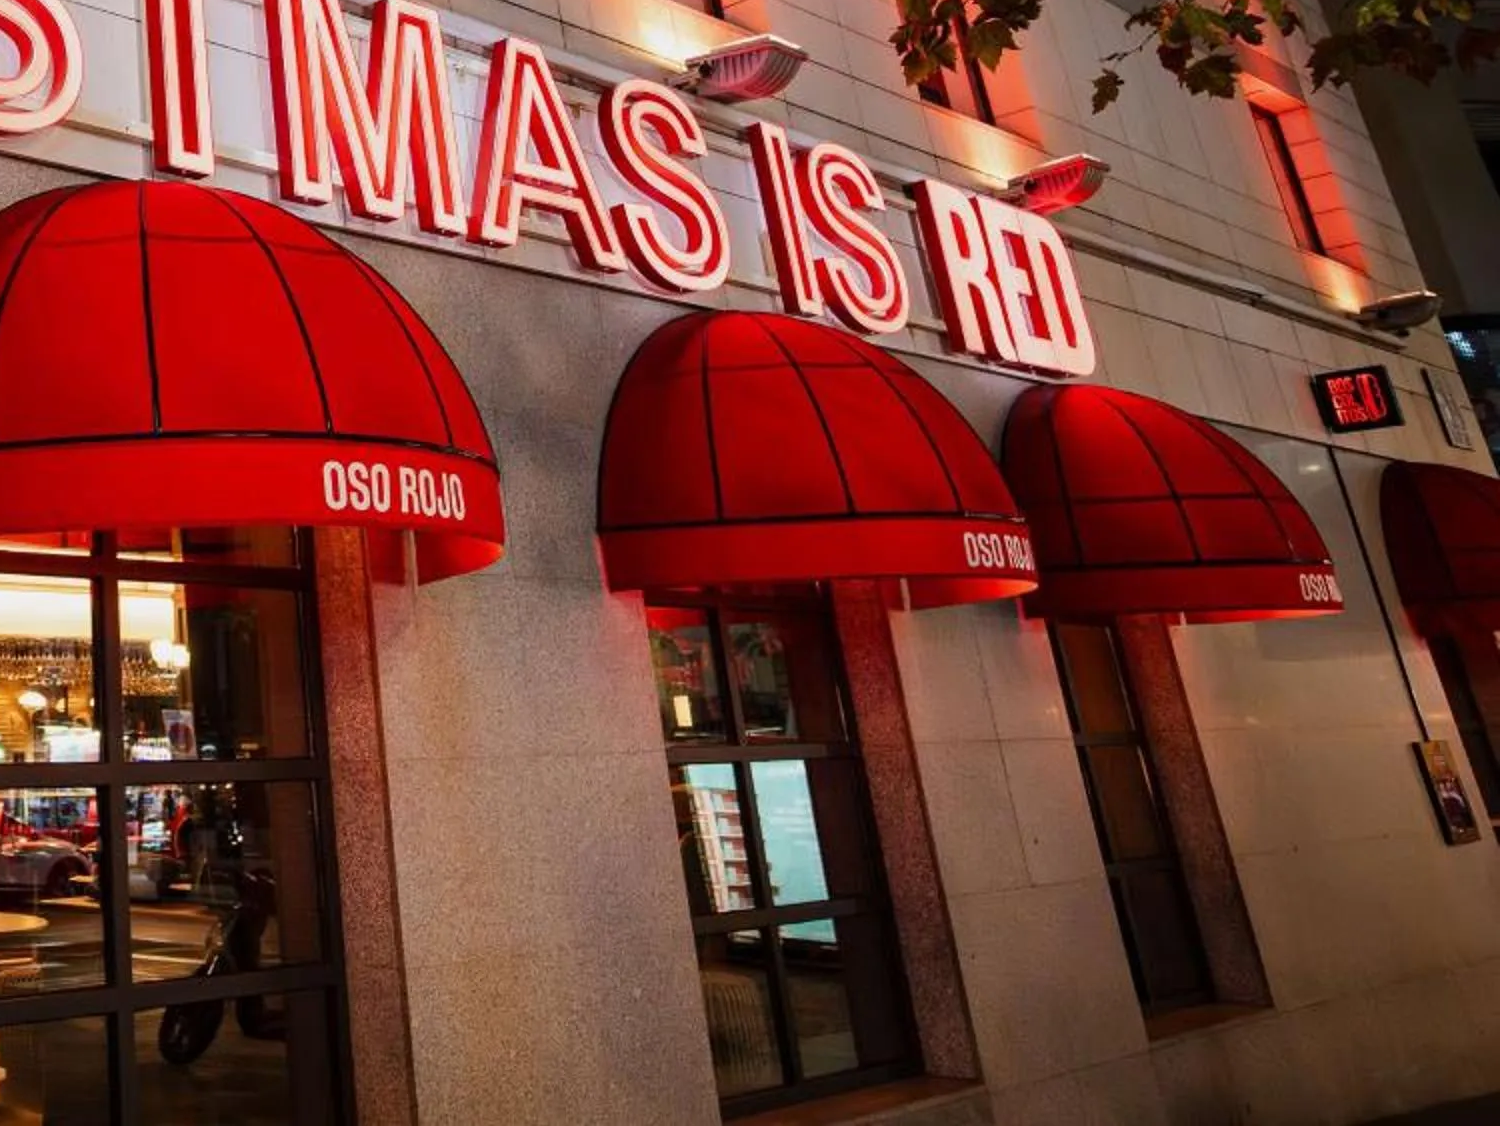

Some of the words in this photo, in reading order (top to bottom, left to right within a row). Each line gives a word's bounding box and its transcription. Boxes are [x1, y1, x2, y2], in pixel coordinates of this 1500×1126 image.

[747, 120, 909, 335] IS
[913, 178, 1096, 377] RED
[323, 460, 392, 513] OSO
[399, 465, 466, 521] ROJO
[963, 531, 1006, 568] OSO
[1299, 573, 1330, 602] OSO
